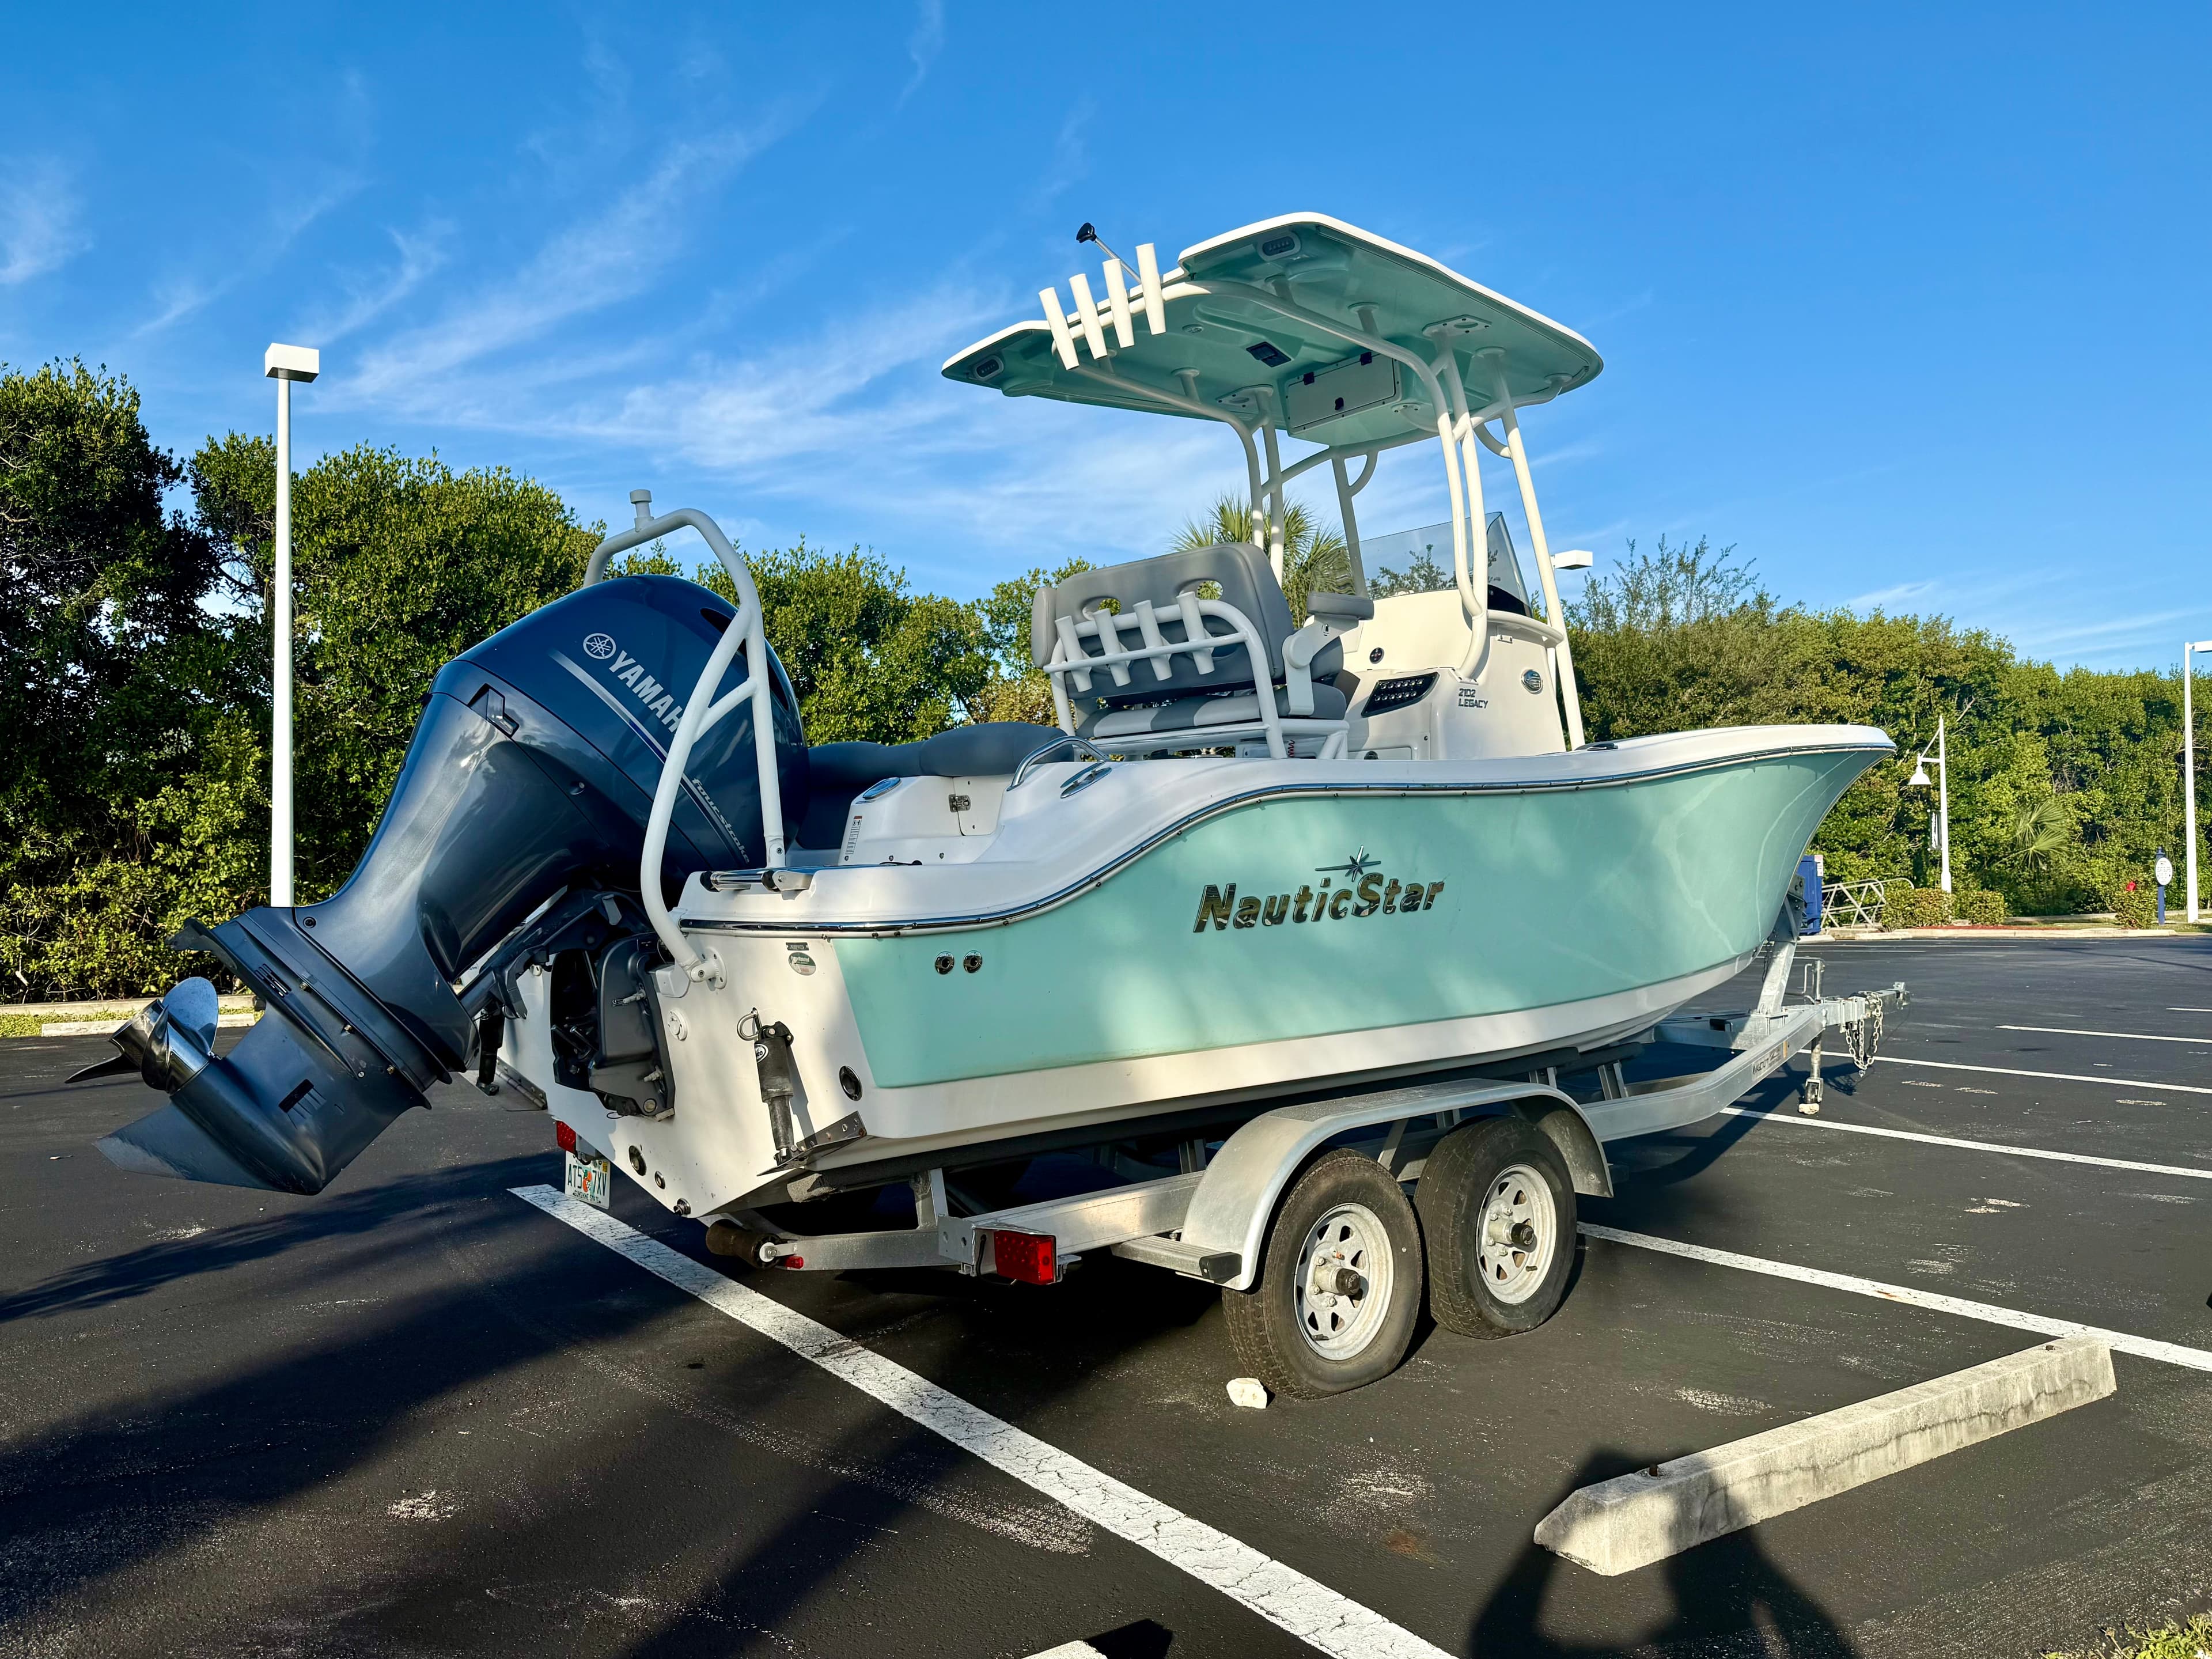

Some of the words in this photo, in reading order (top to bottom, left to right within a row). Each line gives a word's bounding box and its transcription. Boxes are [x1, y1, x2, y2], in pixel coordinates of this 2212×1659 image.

[609, 650, 683, 733] YAMAH
[1458, 698, 1488, 709] LEGACY
[1193, 872, 1445, 933] NauticStar
[592, 1170, 607, 1196] 7XV
